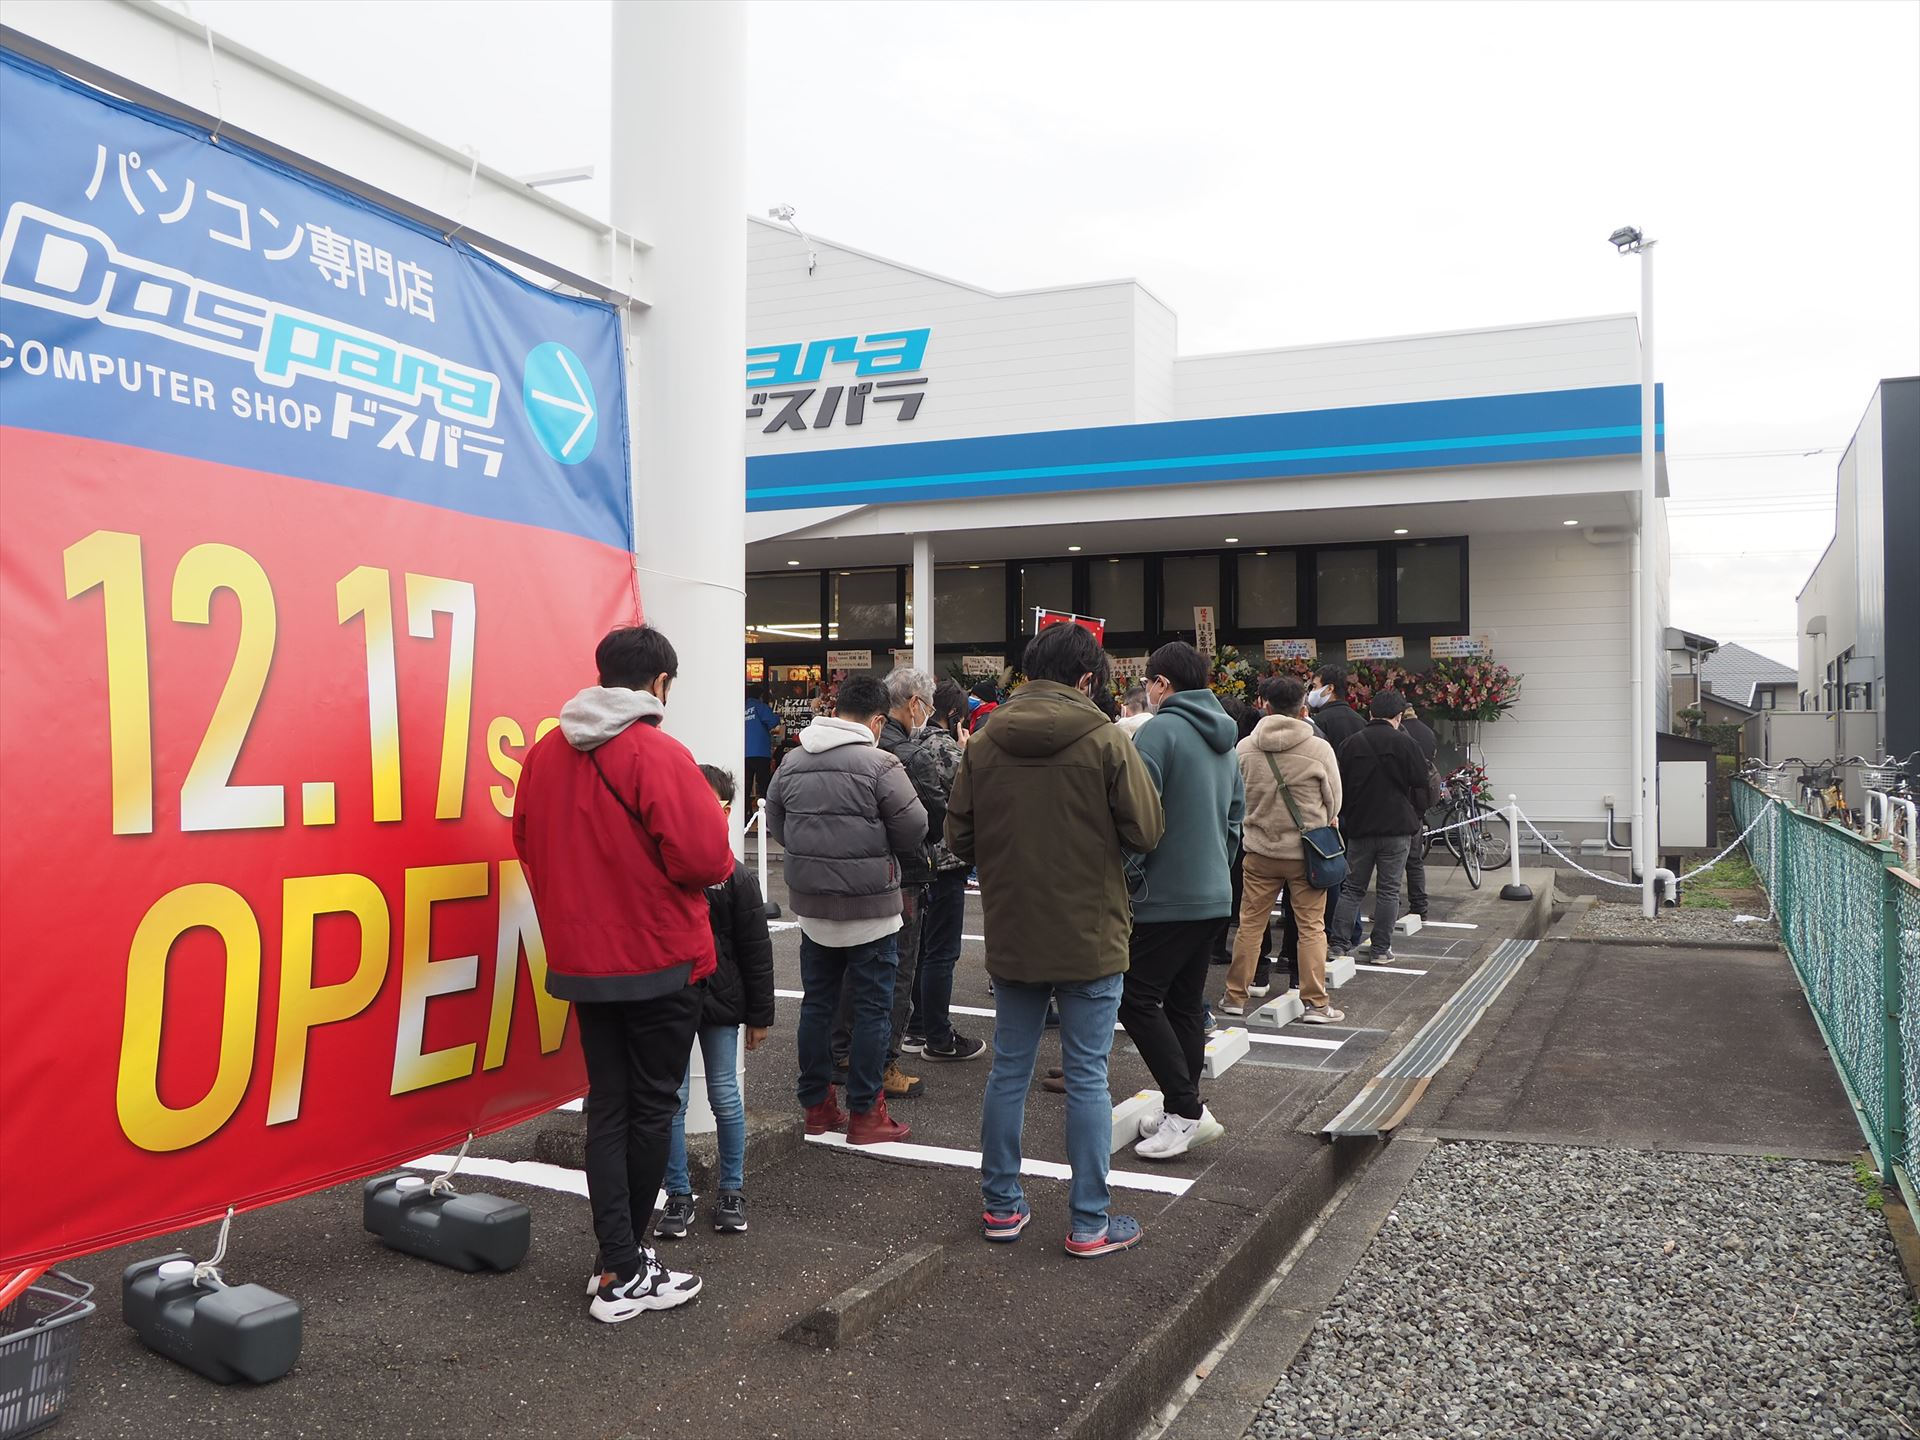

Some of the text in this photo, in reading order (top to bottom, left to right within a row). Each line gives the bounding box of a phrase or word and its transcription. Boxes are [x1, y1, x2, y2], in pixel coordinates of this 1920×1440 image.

[85, 144, 437, 323] パソコン専門店
[0, 333, 322, 431] COMPUTER SHOP
[331, 393, 505, 477] ドスパラ
[63, 529, 476, 834] 12.17
[117, 860, 574, 1152] OPEN
